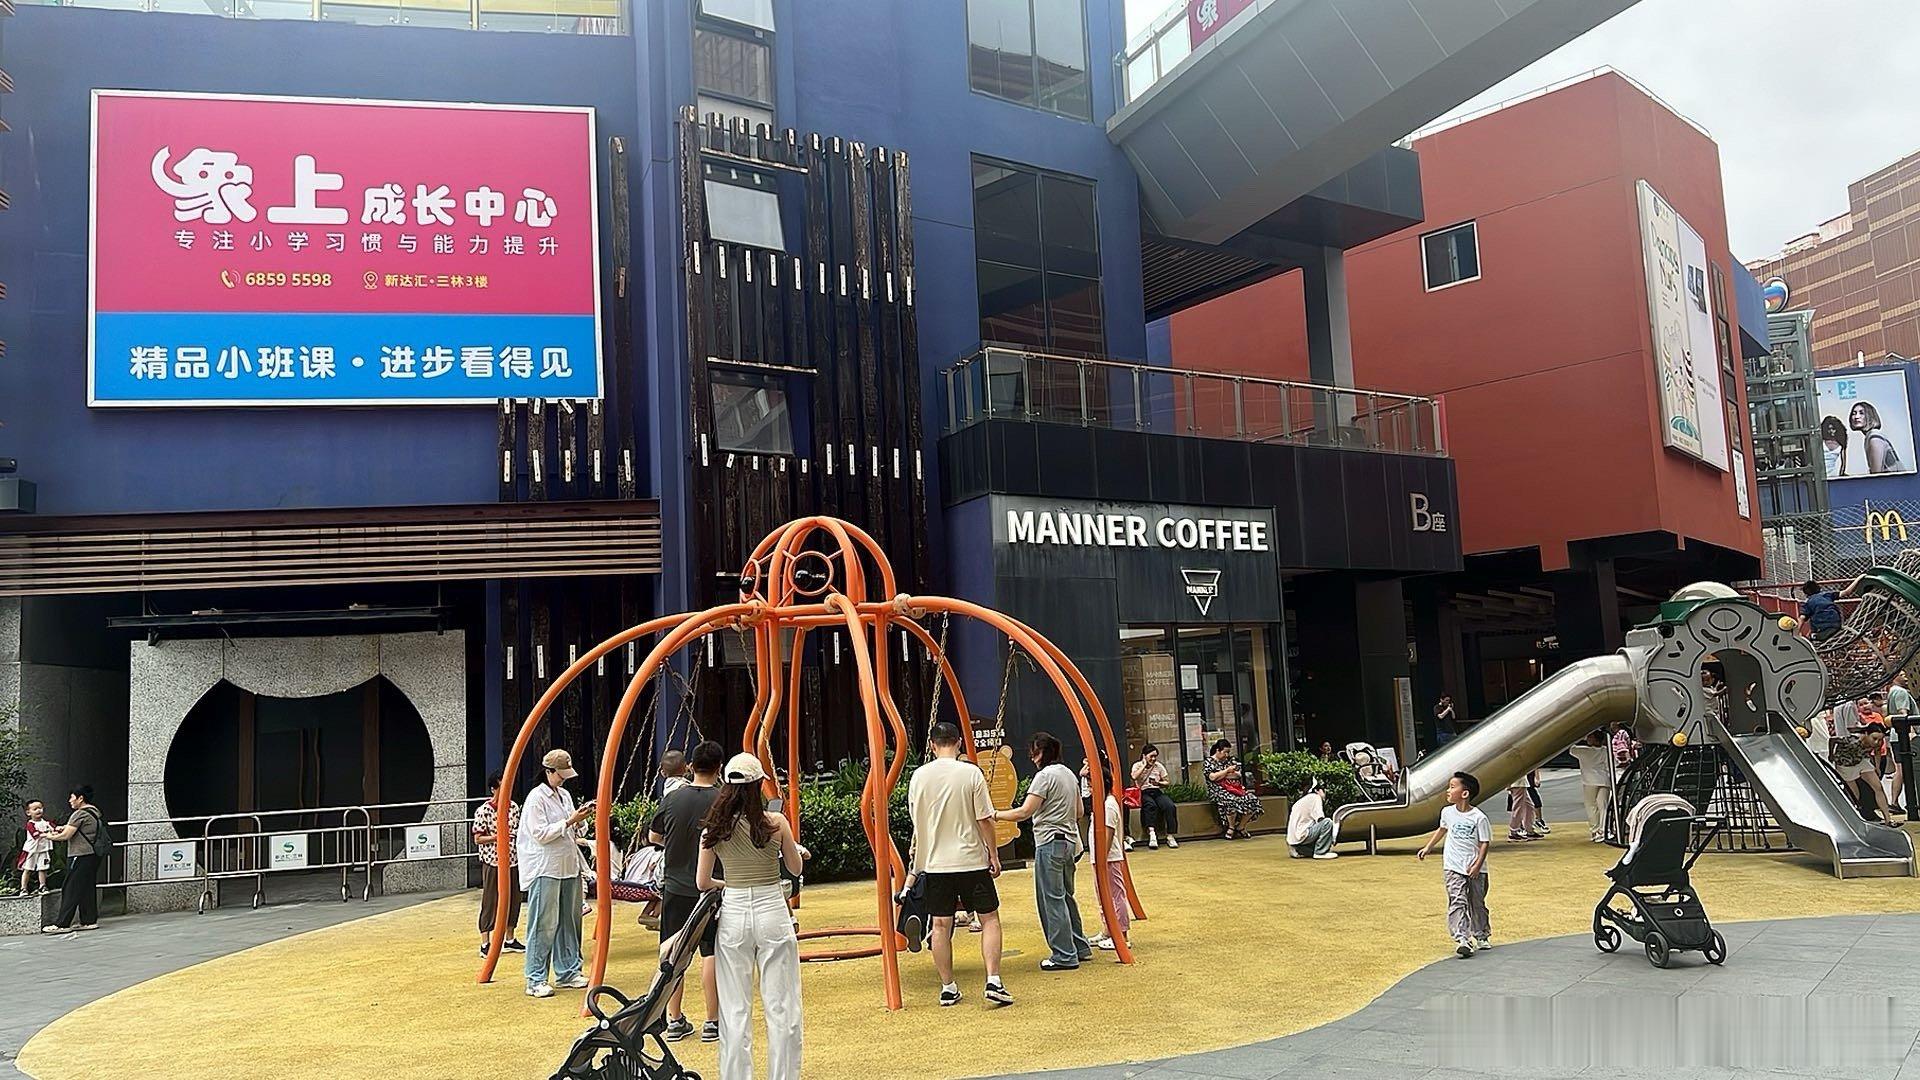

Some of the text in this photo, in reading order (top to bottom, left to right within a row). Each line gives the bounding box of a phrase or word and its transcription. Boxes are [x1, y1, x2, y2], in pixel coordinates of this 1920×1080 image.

[174, 229, 559, 256] 专注小学习惯与能力提升
[245, 272, 332, 287] 6859 5598
[1838, 381, 1857, 395] PE
[1410, 493, 1446, 531] B座
[1007, 510, 1268, 551] MANNER COFFEE
